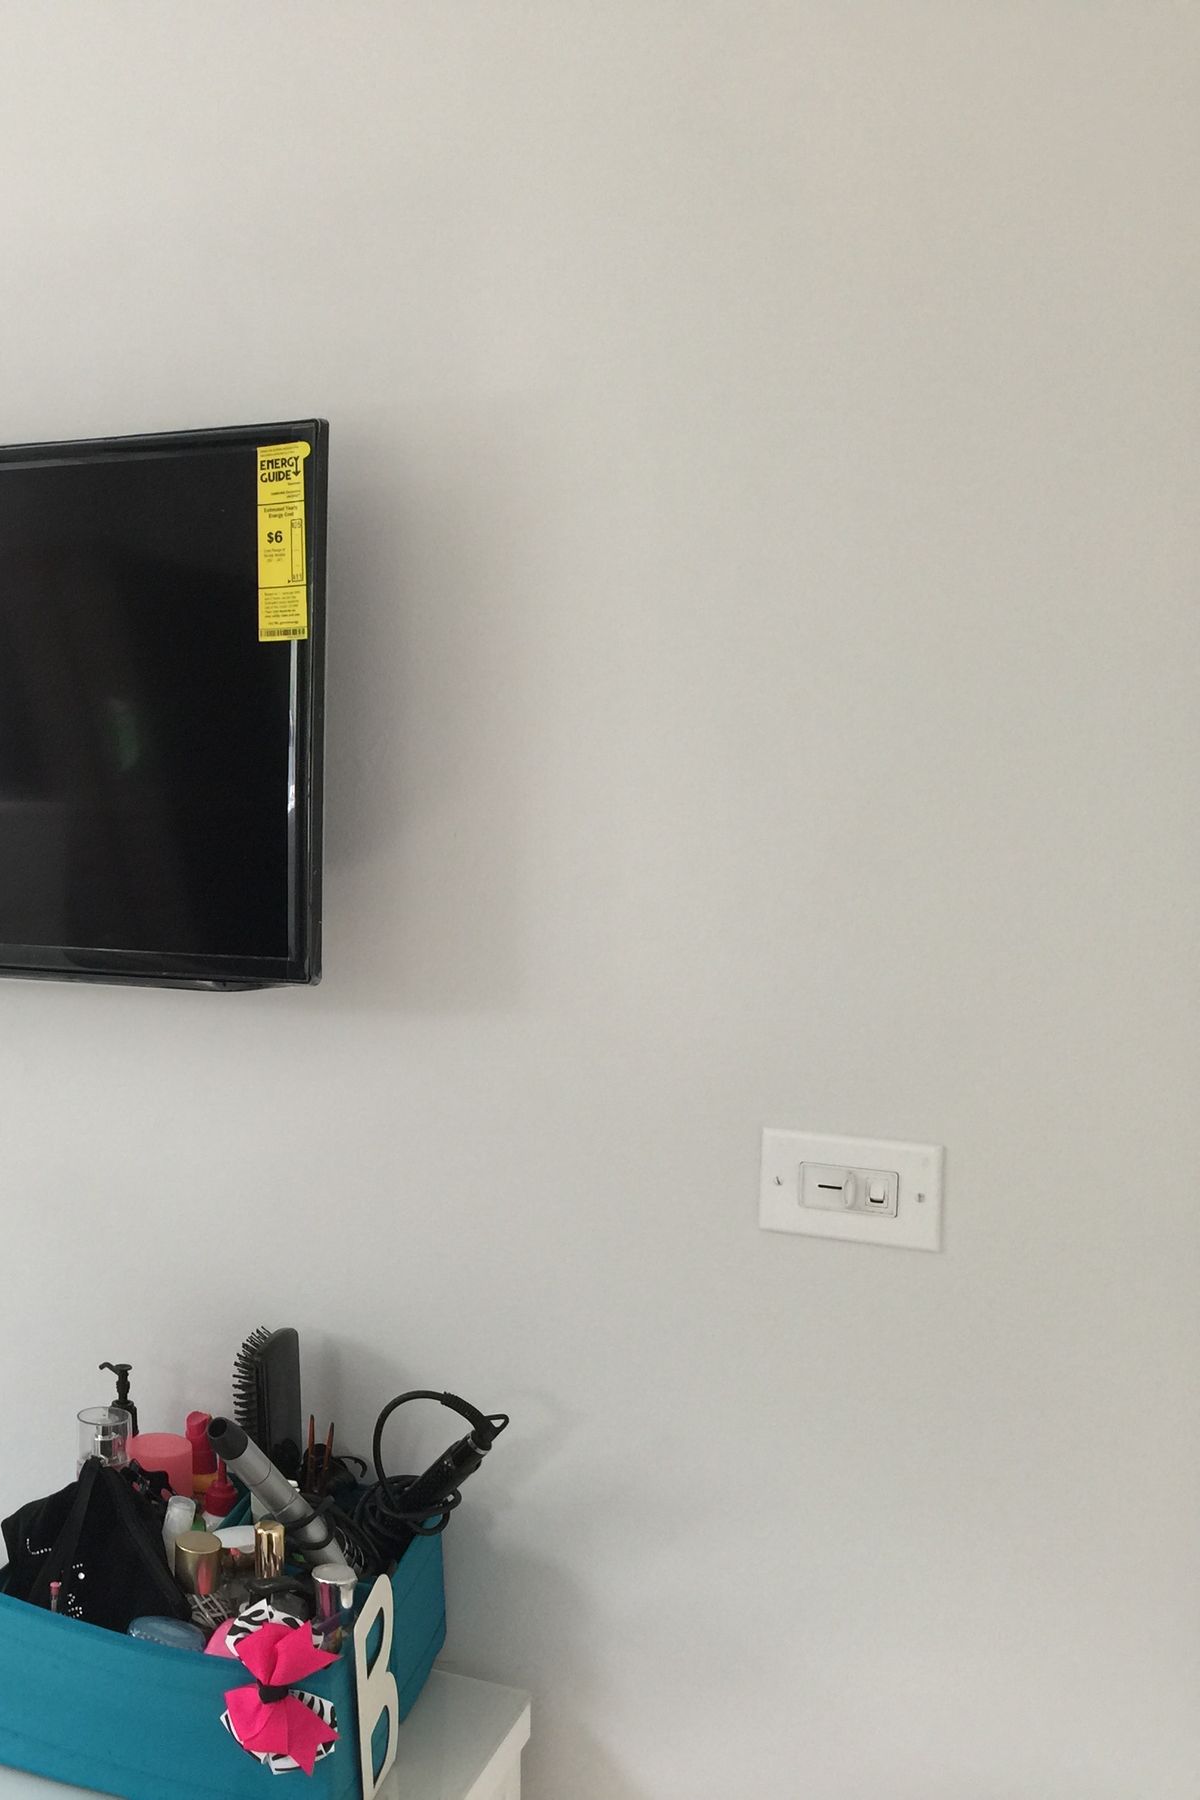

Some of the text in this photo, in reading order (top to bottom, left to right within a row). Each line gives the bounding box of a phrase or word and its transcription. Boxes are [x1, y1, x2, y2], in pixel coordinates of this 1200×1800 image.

[260, 456, 300, 471] ENERGY
[260, 470, 292, 483] GUIDE
[267, 530, 283, 544] $6
[354, 1573, 399, 1800] B
